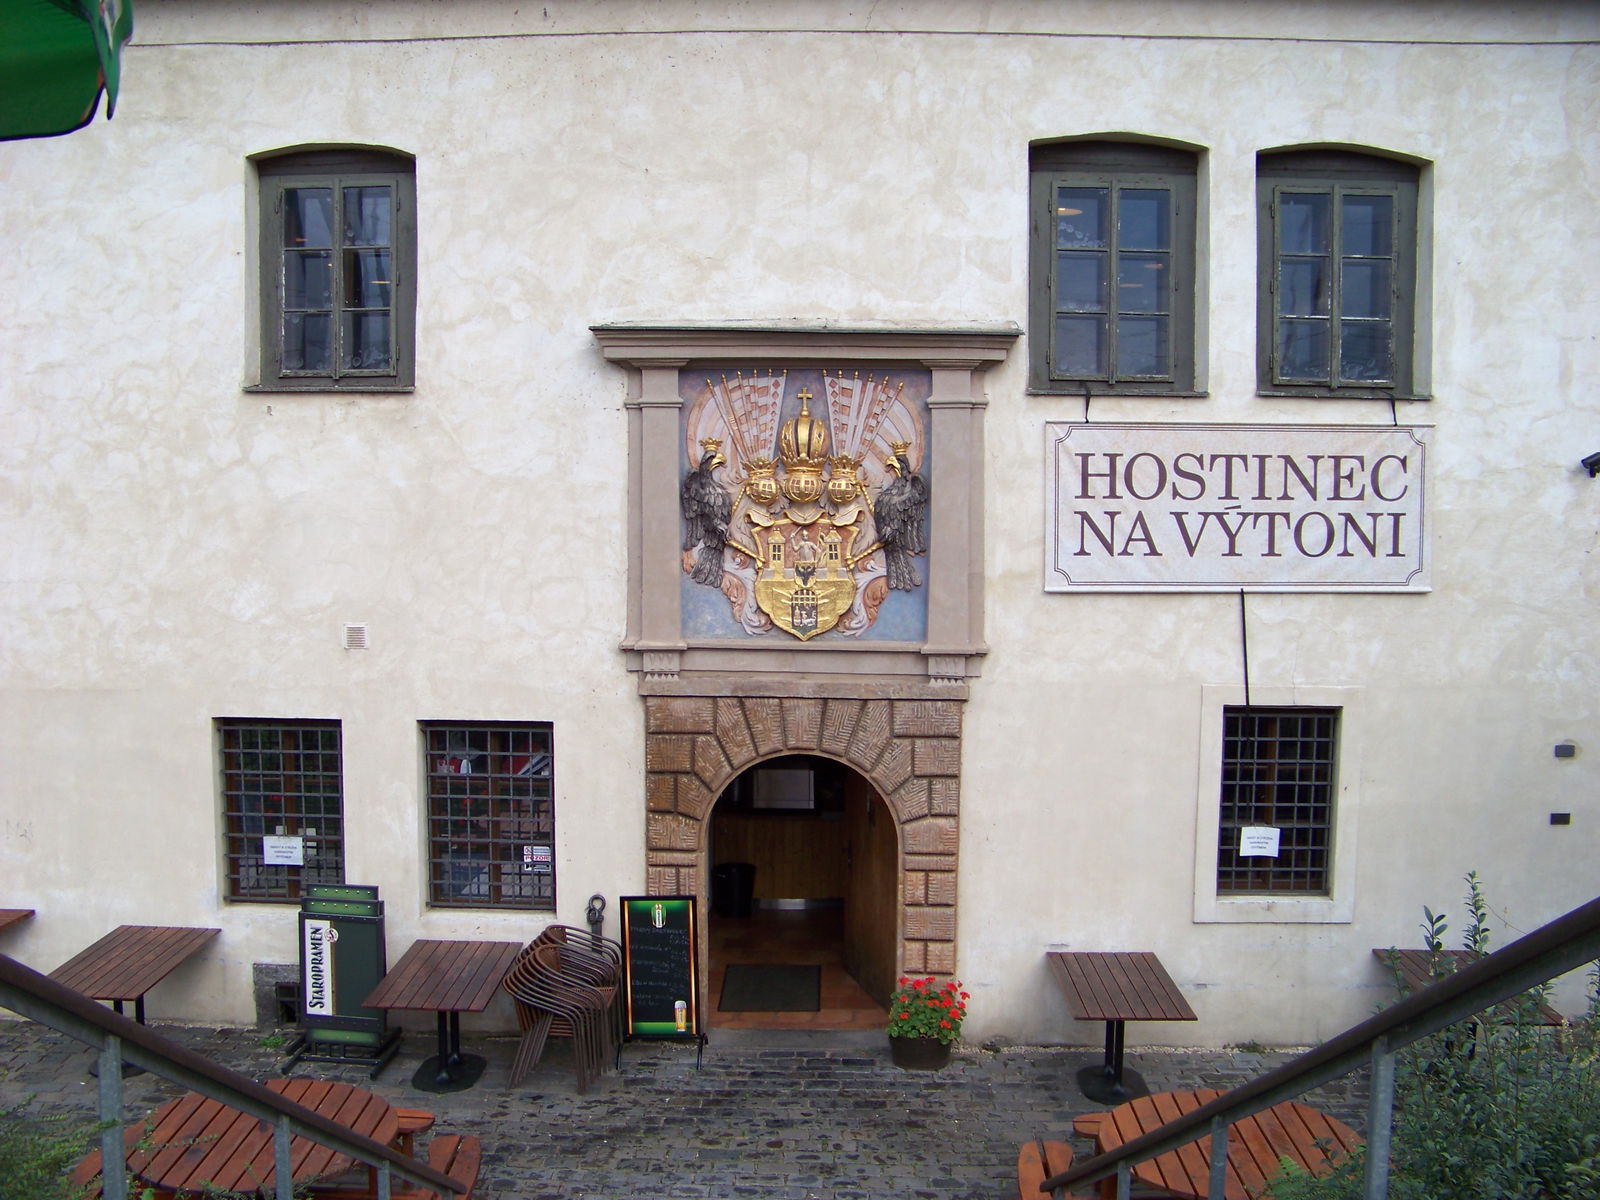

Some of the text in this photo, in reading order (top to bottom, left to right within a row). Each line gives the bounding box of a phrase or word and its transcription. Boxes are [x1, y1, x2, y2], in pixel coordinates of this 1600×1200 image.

[1074, 452, 1408, 502] HOSTINEC
[1073, 504, 1407, 558] NA VÝTONI
[308, 927, 325, 1009] STAROPRAMEN
